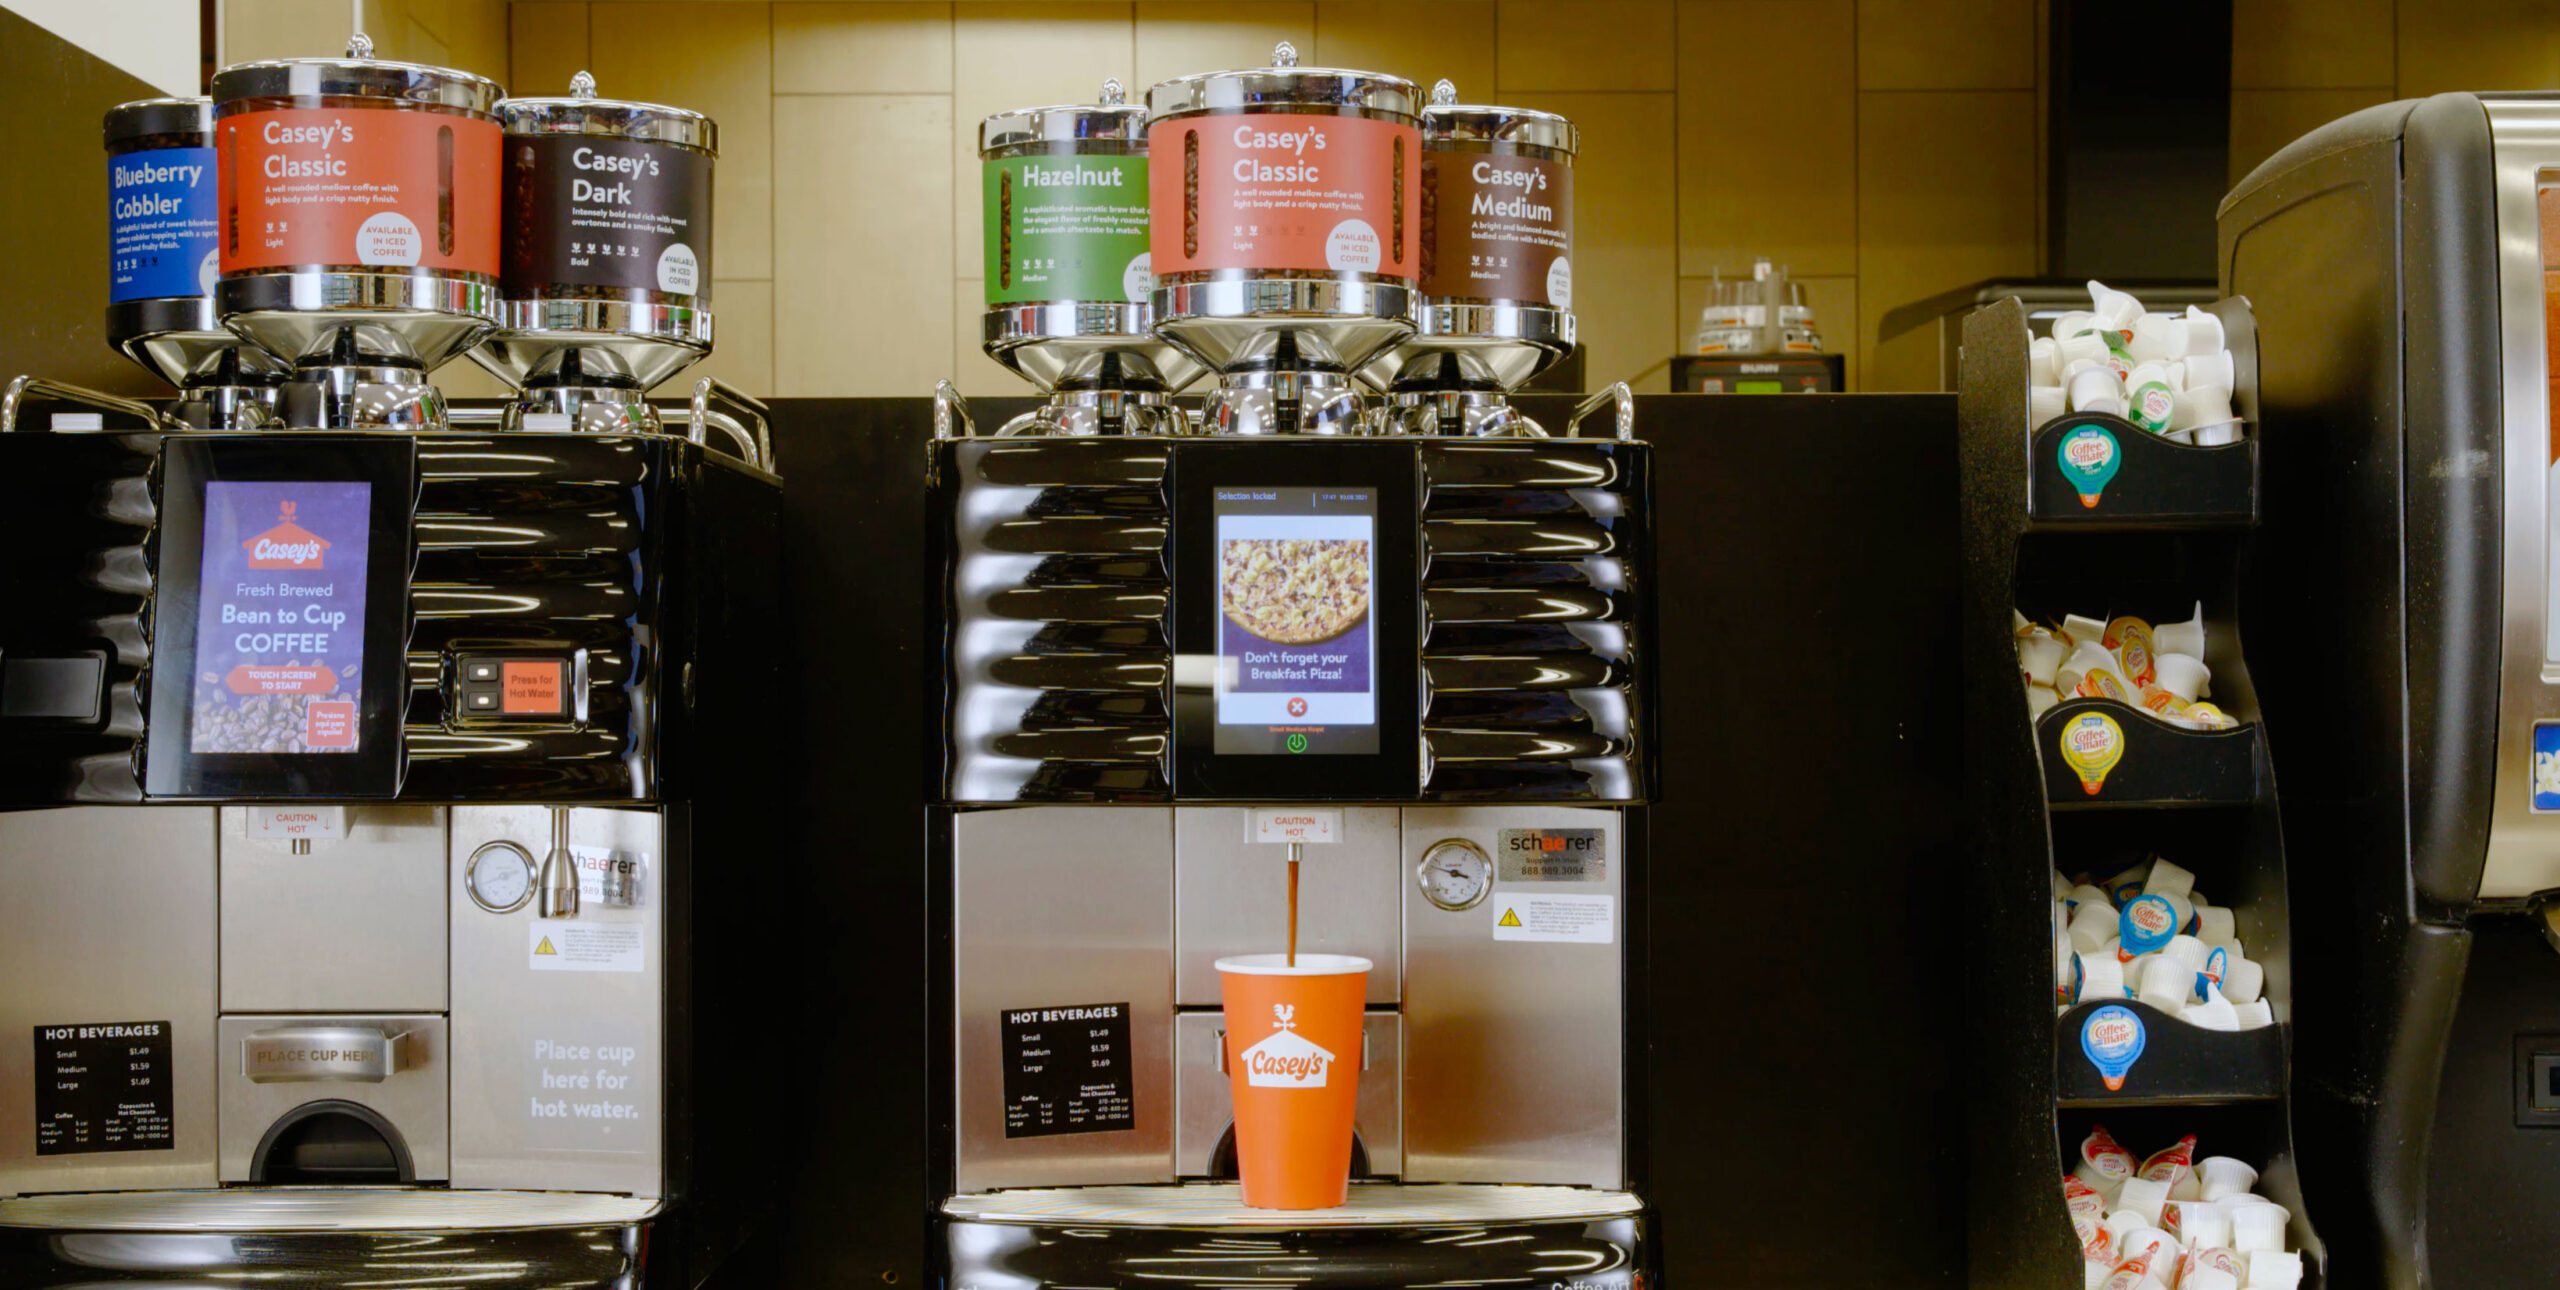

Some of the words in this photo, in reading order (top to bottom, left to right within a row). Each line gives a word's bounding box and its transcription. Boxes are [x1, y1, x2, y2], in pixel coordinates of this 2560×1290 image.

[263, 118, 354, 150] Casey's
[1233, 125, 1327, 156] Casey's
[263, 153, 347, 178] Classic
[572, 147, 660, 181] Casey's
[1233, 158, 1319, 183] Classic
[115, 161, 203, 188] Blueberry
[1023, 163, 1123, 188] Hazelnut
[1472, 161, 1547, 195] Casey's
[265, 185, 271, 193] A
[288, 184, 319, 192] rounded
[321, 183, 350, 191] mellow
[352, 183, 379, 192] coffee
[381, 184, 399, 192] with
[572, 178, 632, 205] Dark
[1234, 189, 1240, 197] A
[1241, 189, 1257, 197] well
[1259, 189, 1292, 197] rounded
[1294, 189, 1322, 198] mellow
[1323, 190, 1347, 199] coffee
[1349, 192, 1364, 200] with
[115, 192, 183, 220] Cobbler
[265, 195, 281, 206] light
[282, 195, 300, 205] body
[303, 195, 317, 203] and
[326, 194, 346, 205] crisp
[348, 195, 370, 205] nutty
[372, 195, 398, 203] finish.
[1233, 200, 1251, 210] light
[1253, 200, 1273, 209] body
[1275, 199, 1290, 208] and
[1298, 200, 1318, 210] crisp
[1319, 201, 1340, 211] nutty
[1341, 201, 1363, 211] finish.
[1023, 206, 1029, 214] A
[1109, 205, 1128, 214] brew
[1130, 206, 1146, 214] that
[1471, 192, 1552, 222] Medium
[572, 207, 608, 219] Intensely
[609, 209, 626, 218] bold
[627, 211, 641, 220] and
[642, 212, 656, 220] rich
[656, 214, 671, 223] with
[1082, 215, 1091, 224] of
[1092, 215, 1118, 226] freshly
[1120, 217, 1149, 225] roasted
[365, 227, 413, 236] AVAILABLE
[571, 219, 611, 228] overtones
[611, 220, 626, 229] and
[633, 223, 656, 234] smoky
[1115, 227, 1142, 235] match.
[1472, 221, 1478, 229] A
[1479, 220, 1502, 232] bright
[1502, 223, 1516, 231] and
[265, 238, 284, 248] Light
[373, 237, 383, 245] IN
[385, 238, 407, 246] ICED
[1334, 232, 1375, 243] AVAILABLE
[1471, 231, 1497, 240] bodied
[1498, 232, 1519, 242] coffee
[372, 248, 407, 257] COFFEE
[1233, 241, 1254, 252] Light
[1340, 244, 1350, 252] IN
[1351, 244, 1369, 253] ICED
[570, 257, 589, 267] Bold
[664, 255, 695, 267] AVAILABLE
[1339, 254, 1369, 264] COFFEE
[668, 276, 691, 287] COFFEE
[1022, 274, 1048, 283] Medium
[1470, 270, 1501, 280] Medium
[2071, 442, 2103, 457] Coffee
[2080, 451, 2106, 463] mate
[1217, 491, 1250, 501] Selection
[1252, 491, 1277, 501] locked
[254, 538, 321, 565] Casey's
[236, 583, 275, 597] Fresh
[279, 583, 334, 598] Brewed
[221, 604, 272, 625] Bean
[277, 607, 297, 625] to
[303, 603, 347, 632] Cup
[235, 632, 329, 654] COFFEE
[1244, 652, 1279, 665] Don't
[1281, 652, 1319, 668] forget
[1321, 654, 1349, 668] your
[248, 670, 279, 681] TOUCH
[281, 670, 317, 681] SCREEN
[511, 675, 538, 685] Press
[539, 675, 554, 685] for
[1251, 667, 1307, 681] Breakfast
[1310, 667, 1343, 681] Pizza!
[261, 681, 274, 691] TO
[276, 681, 303, 691] START
[509, 688, 526, 698] Hot
[527, 688, 555, 699] Water
[2074, 730, 2105, 745] Coffee
[2082, 738, 2108, 750] mate
[275, 813, 318, 822] CAUTION
[1274, 816, 1316, 826] CAUTION
[287, 825, 307, 834] HOT
[1285, 828, 1305, 837] HOT
[1509, 833, 1595, 853] schaerer
[573, 850, 638, 875] haerer
[2135, 905, 2164, 923] Coffee
[2137, 917, 2162, 930] mate
[1010, 1011, 1038, 1025] HOT
[1042, 1006, 1118, 1022] BEVERAGES
[45, 1028, 75, 1041] HOT
[79, 1024, 160, 1039] BEVERAGES
[1021, 1033, 1041, 1042] Small
[1089, 1028, 1109, 1038] $1.49
[2095, 1023, 2126, 1039] Coffee
[2103, 1032, 2129, 1046] mate
[56, 1050, 77, 1059] Small
[129, 1047, 150, 1056] $1.49
[256, 1049, 306, 1064] PLACE
[309, 1050, 339, 1063] CUP
[534, 1038, 591, 1061] Place
[597, 1045, 636, 1067] cup
[1022, 1048, 1051, 1058] Medium
[1090, 1043, 1110, 1053] $1.59
[57, 1066, 88, 1074] Medium
[130, 1062, 150, 1071] $1.59
[1023, 1064, 1043, 1074] Large
[1091, 1058, 1111, 1068] $1.69
[1251, 1049, 1323, 1081] Casey's
[57, 1081, 79, 1091] Large
[130, 1077, 150, 1087] $1.69
[541, 1067, 590, 1090] here
[595, 1068, 628, 1090] for
[1021, 1095, 1039, 1103] Coffee
[530, 1096, 568, 1118] hot
[572, 1100, 640, 1120] water.
[55, 1112, 74, 1120] Coffee
